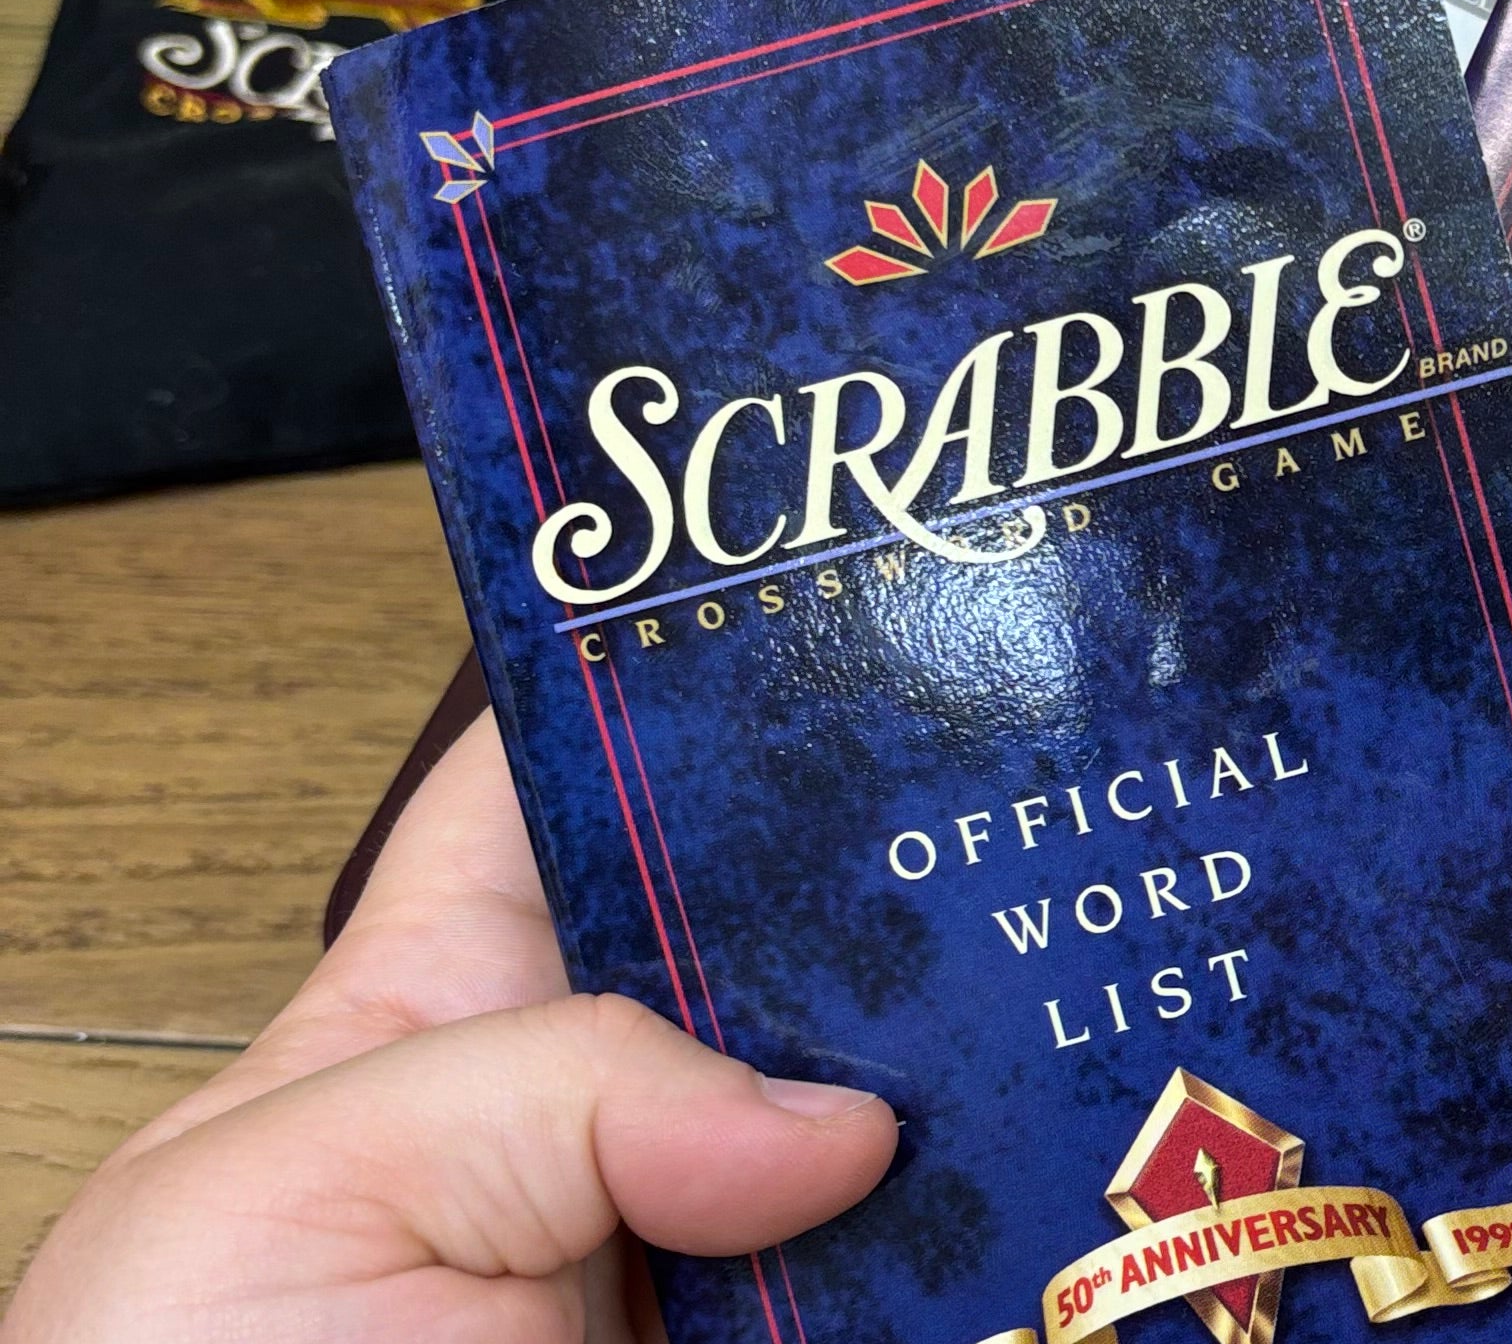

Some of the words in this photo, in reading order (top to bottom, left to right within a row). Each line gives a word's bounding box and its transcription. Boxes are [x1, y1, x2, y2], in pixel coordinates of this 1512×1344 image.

[1418, 337, 1509, 379] BRAND
[1211, 411, 1427, 493] GAME
[888, 732, 1309, 880] OFFICIAL
[990, 850, 1252, 955] WORD
[1044, 949, 1249, 1049] LIST
[1056, 1266, 1113, 1329] 50th
[1119, 1203, 1393, 1295] ANNIVERSARY
